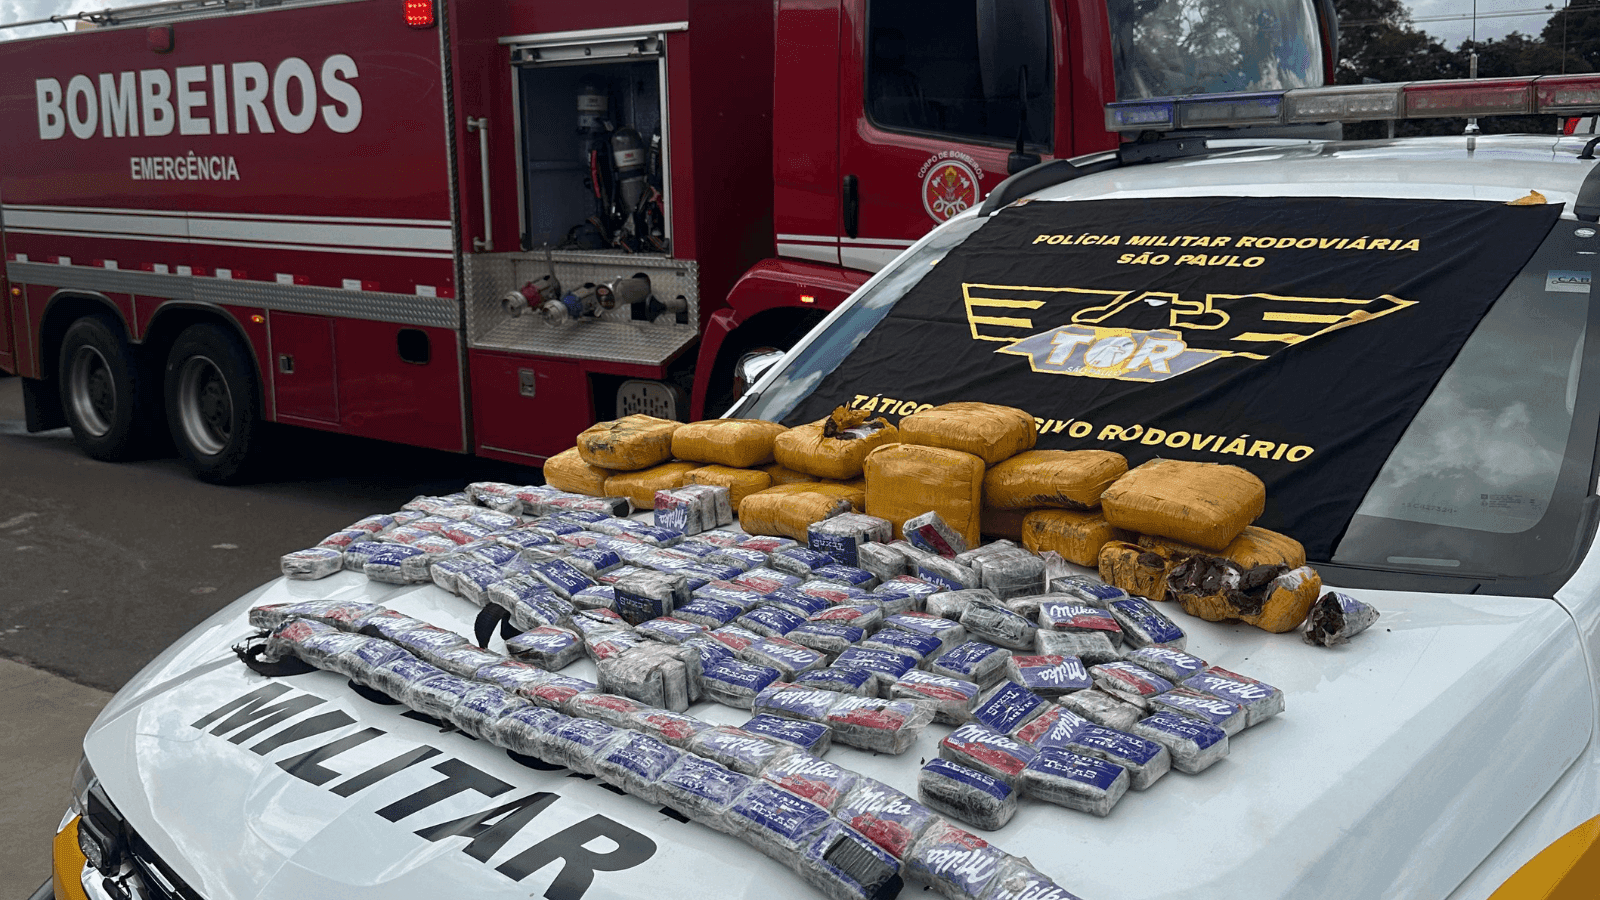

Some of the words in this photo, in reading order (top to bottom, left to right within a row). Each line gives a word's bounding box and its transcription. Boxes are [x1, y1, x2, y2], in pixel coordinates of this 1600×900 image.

[36, 54, 363, 140] BOMBEIROS
[130, 151, 240, 181] EMERGÊNCIA
[917, 155, 938, 179] CORPO
[938, 151, 948, 159] DE
[949, 150, 985, 180] BOMBEIROS
[1032, 232, 1121, 247] POLÍCIA
[1125, 235, 1227, 249] MILITAR
[1234, 235, 1421, 252] RODOVIÁRIA
[1116, 252, 1171, 266] SÃO
[1174, 254, 1266, 269] PAULO
[1045, 330, 1187, 373] TOR
[1097, 424, 1315, 463] RODOVIÁRIO
[1050, 605, 1100, 619] Milka
[1037, 661, 1088, 685] Milka
[1204, 676, 1267, 699] Milka
[955, 724, 1020, 751] Milka
[1050, 707, 1088, 741] Milka
[777, 753, 839, 778] Milka
[190, 681, 658, 900] MILITAR
[926, 848, 995, 884] Milka
